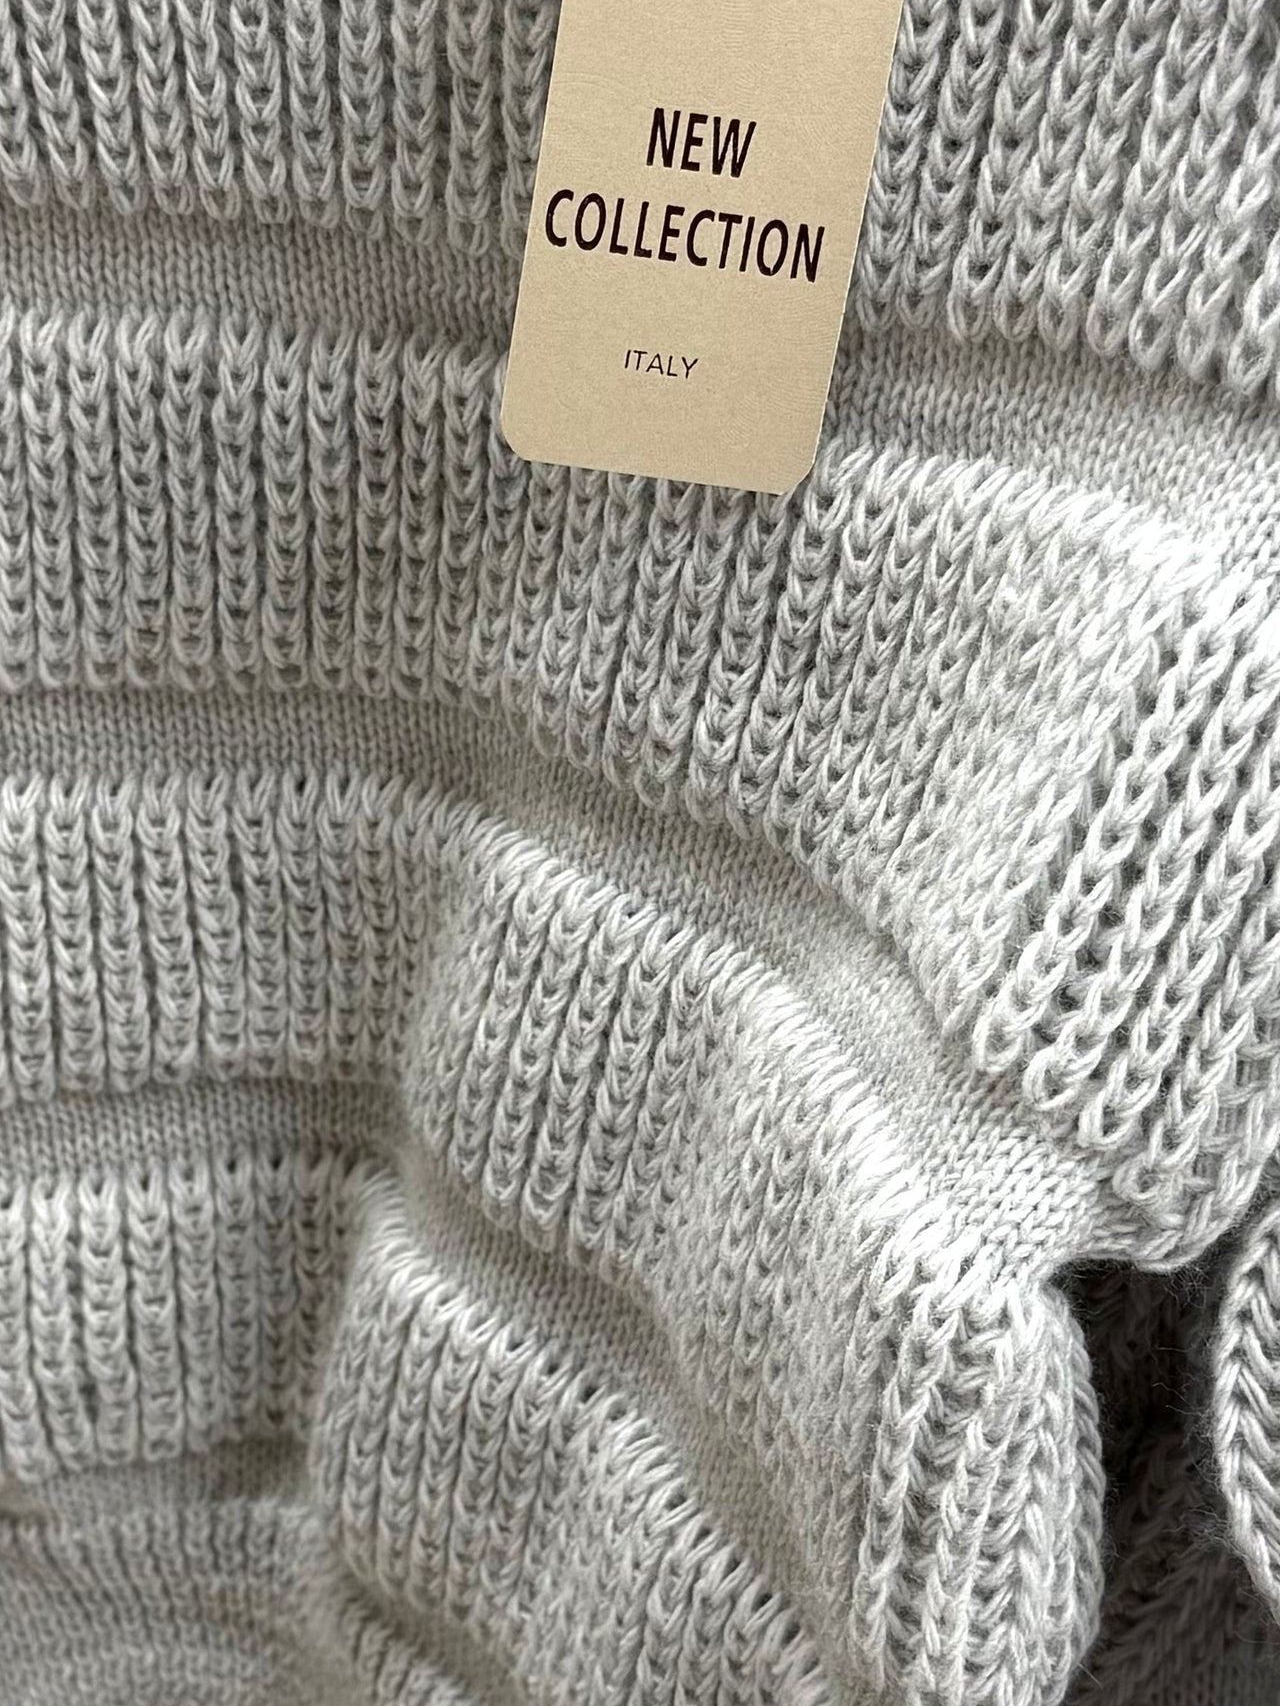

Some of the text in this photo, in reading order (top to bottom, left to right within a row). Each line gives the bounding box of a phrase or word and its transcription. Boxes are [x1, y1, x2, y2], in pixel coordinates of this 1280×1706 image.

[646, 107, 757, 179] NEW
[545, 188, 826, 283] COLLECTION
[624, 349, 699, 379] ITALY
